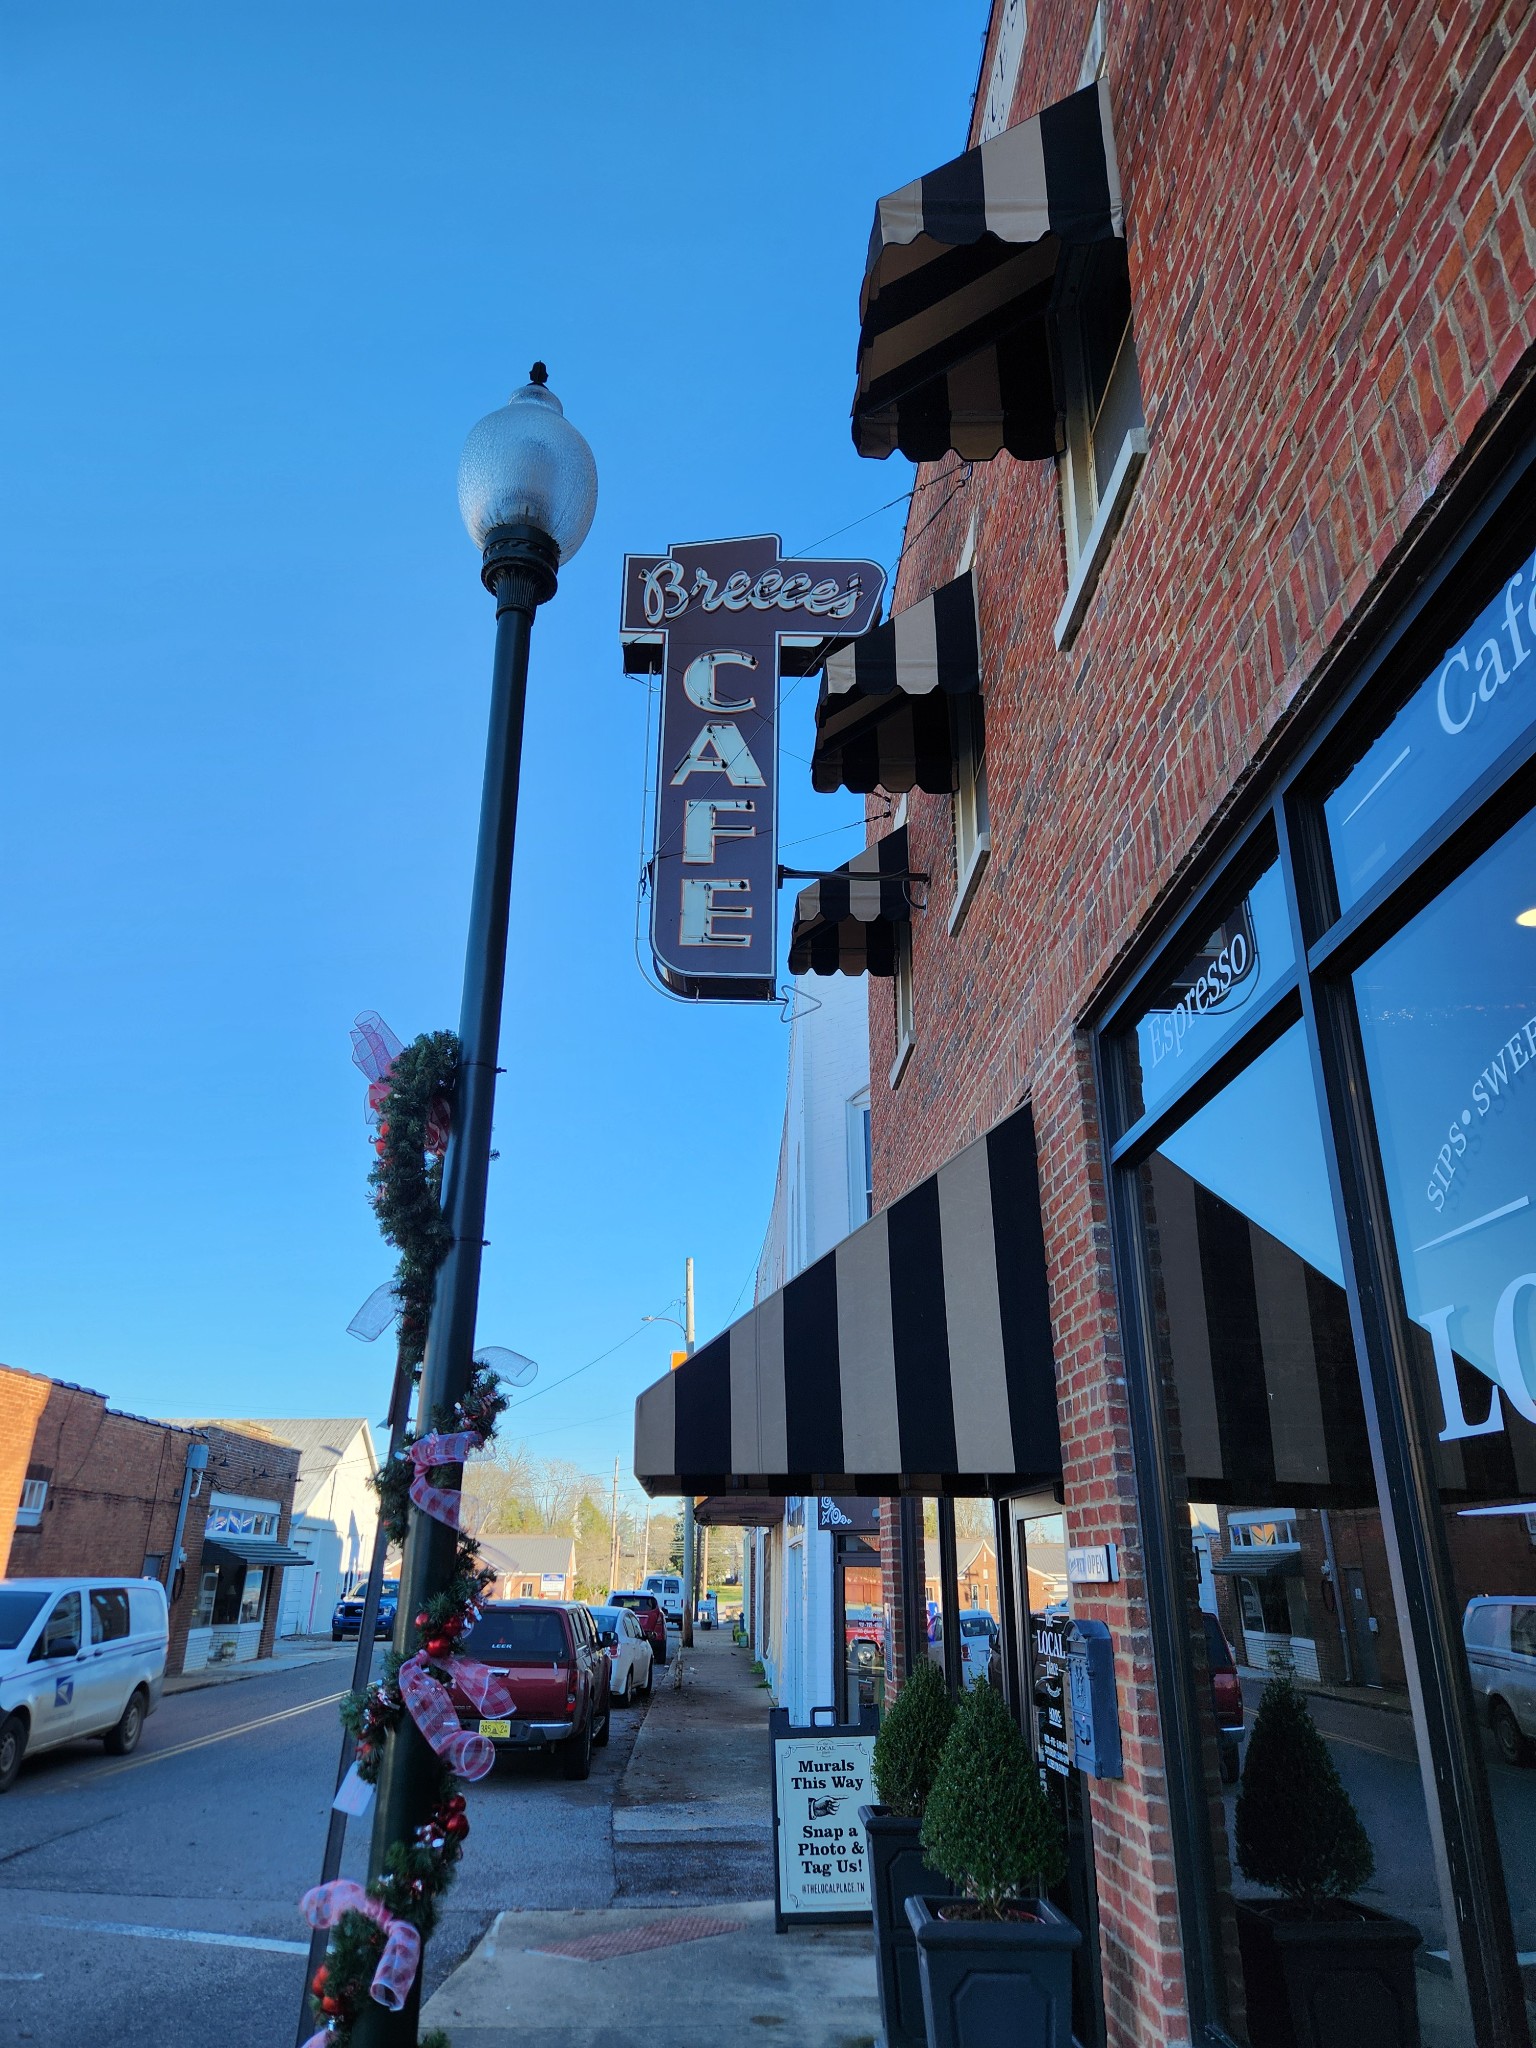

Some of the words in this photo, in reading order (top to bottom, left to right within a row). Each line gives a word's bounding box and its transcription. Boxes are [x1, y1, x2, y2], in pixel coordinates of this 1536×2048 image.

[670, 648, 767, 947] CAFE
[1148, 933, 1247, 1068] Espresso
[1037, 1630, 1066, 1659] LOCAL
[798, 1759, 855, 1772] Murals
[791, 1777, 826, 1789] This
[831, 1776, 864, 1791] Way
[803, 1825, 843, 1841] Snap
[848, 1827, 858, 1837] a
[798, 1843, 846, 1856] Photo
[851, 1841, 864, 1854] &
[802, 1861, 832, 1877] Tag
[837, 1859, 863, 1873] Us!
[802, 1882, 865, 1895] @THELOCALPLACE.TN
